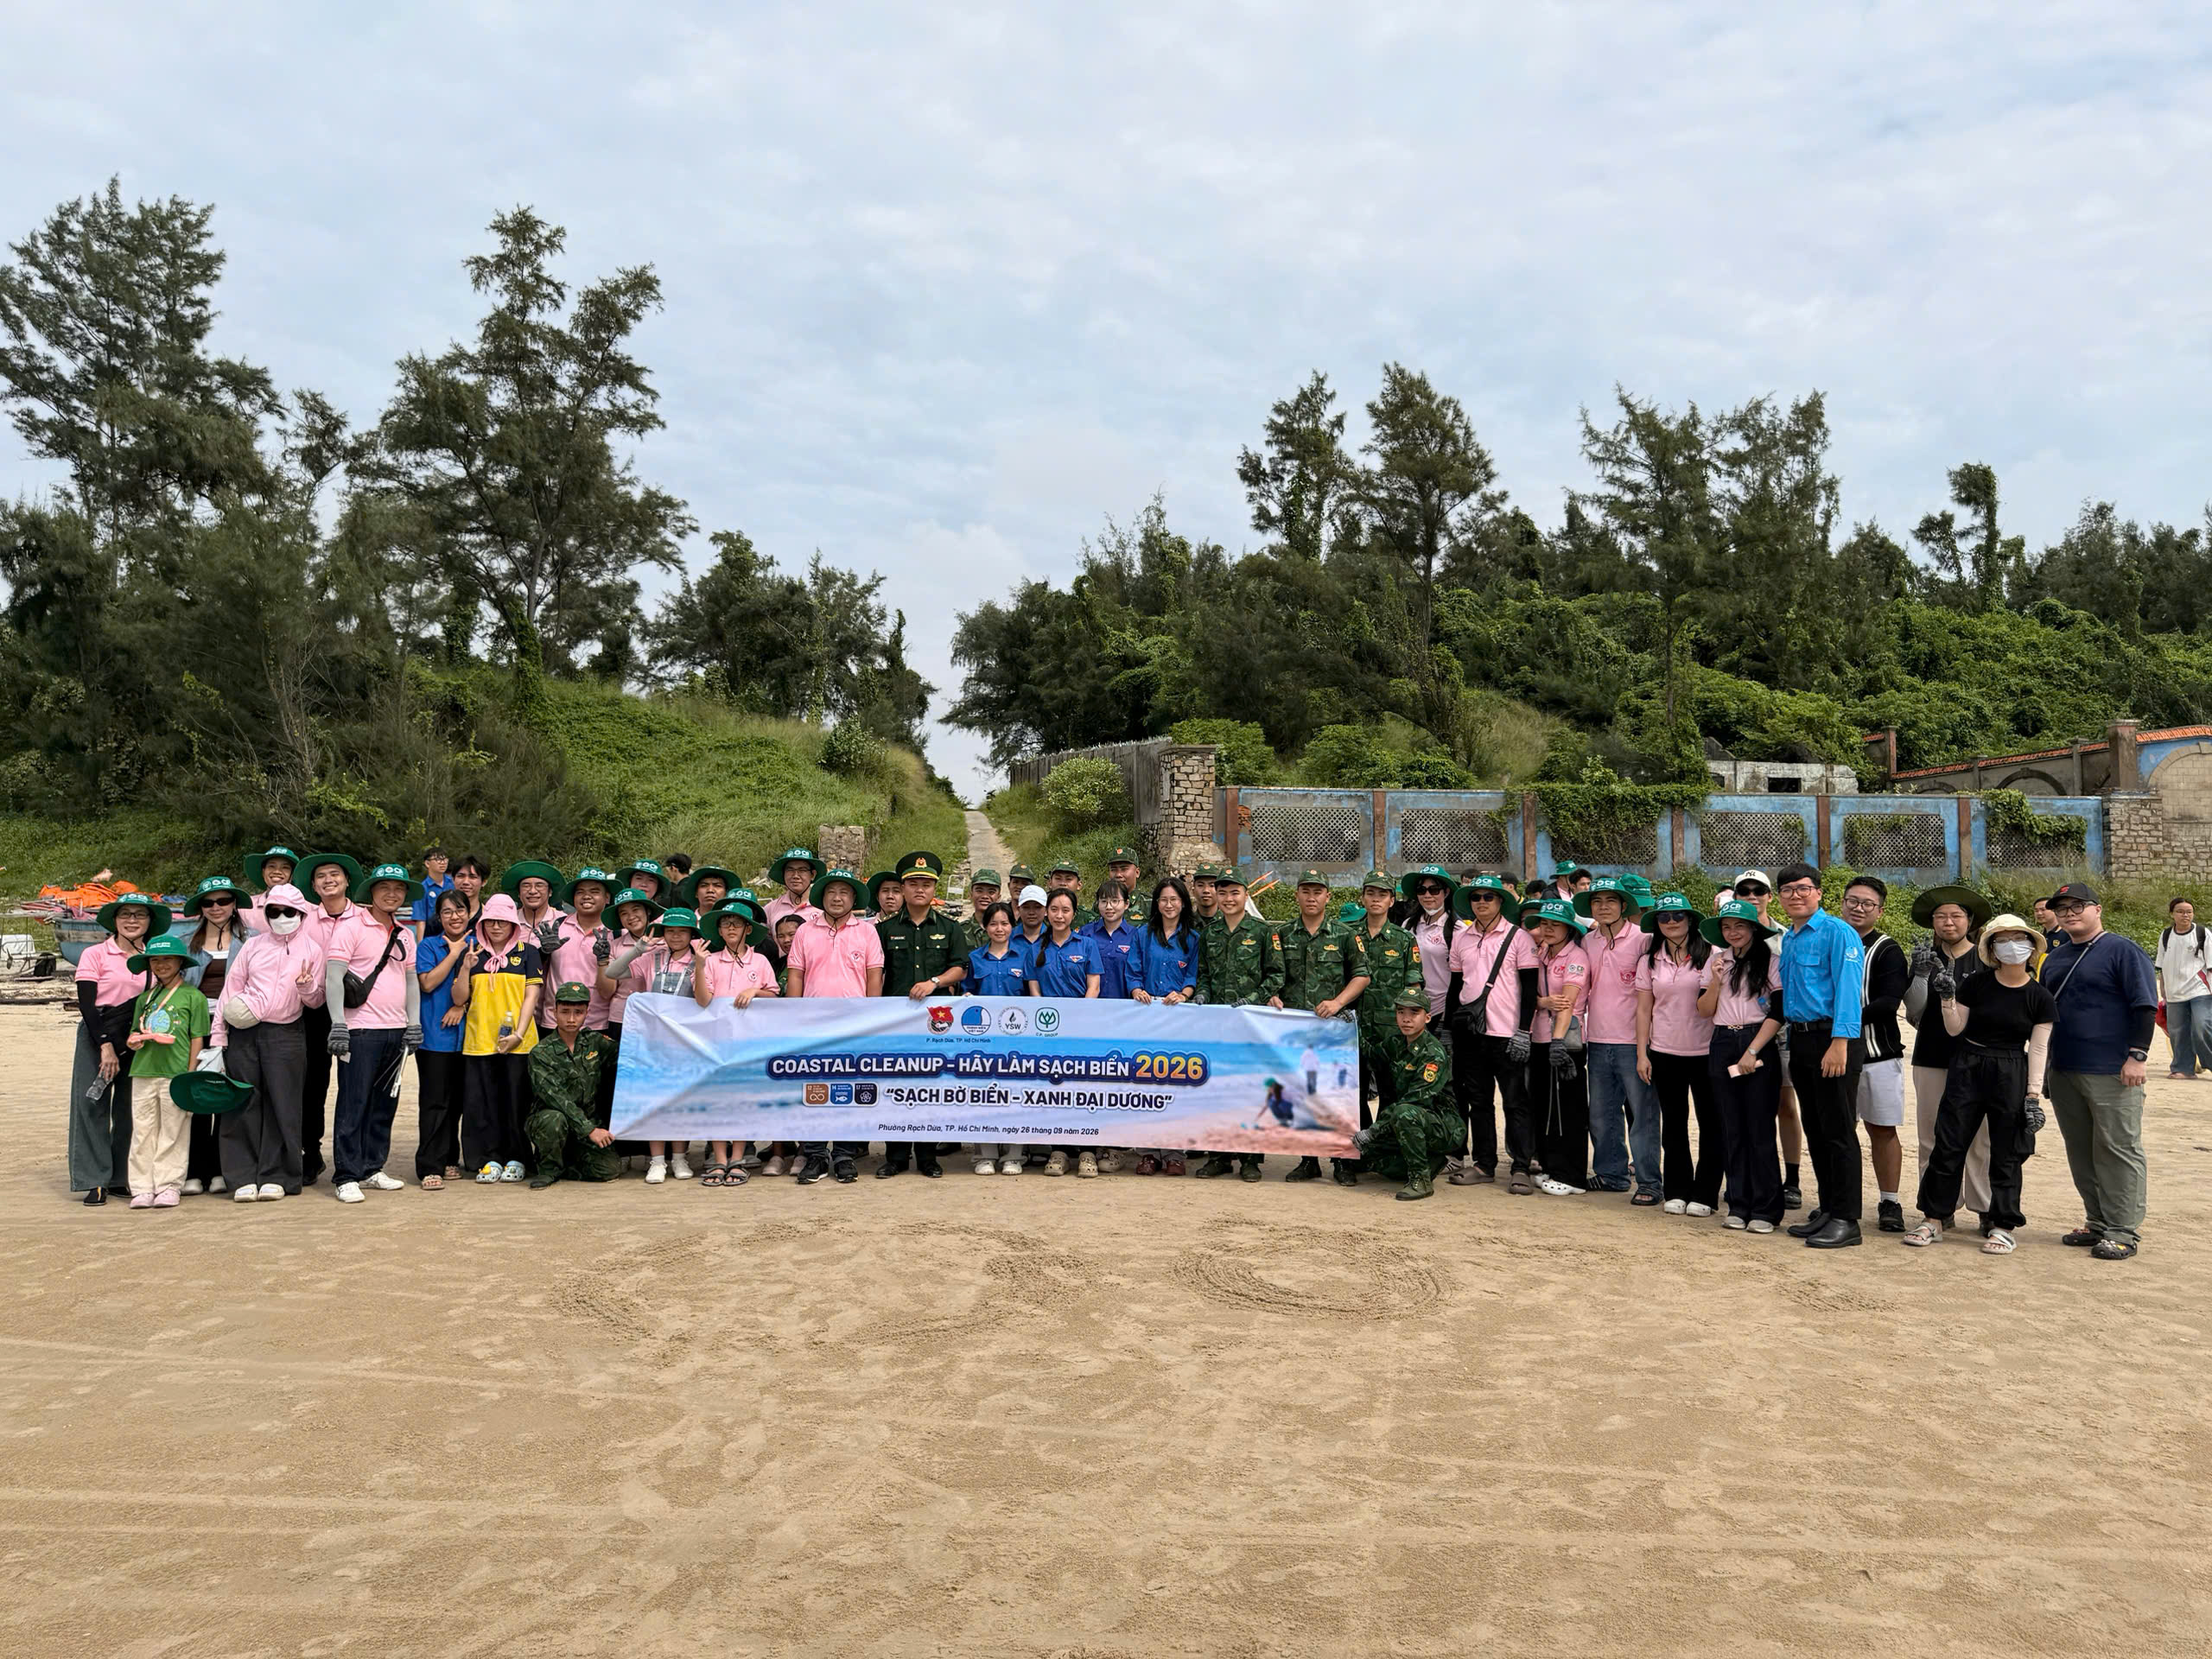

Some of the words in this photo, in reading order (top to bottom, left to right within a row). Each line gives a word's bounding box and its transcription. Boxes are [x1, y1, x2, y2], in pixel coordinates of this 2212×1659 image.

[772, 1058, 855, 1074] COASTAL
[860, 1057, 943, 1072] CLEANUP
[958, 1055, 991, 1072] HÃY
[998, 1055, 1035, 1073] LÀM
[1039, 1058, 1086, 1078] SẠCH
[1090, 1054, 1129, 1077] BIỂN
[1135, 1055, 1204, 1079] 2026
[944, 1086, 968, 1103] BỜ
[970, 1083, 1009, 1104] BIỂN
[1024, 1090, 1071, 1106] XANH
[1076, 1092, 1104, 1111] ĐẠI
[878, 1123, 906, 1133] Phường
[907, 1124, 925, 1133] Rạch
[1002, 1126, 1020, 1135] ngày
[1032, 1126, 1052, 1135] tháng
